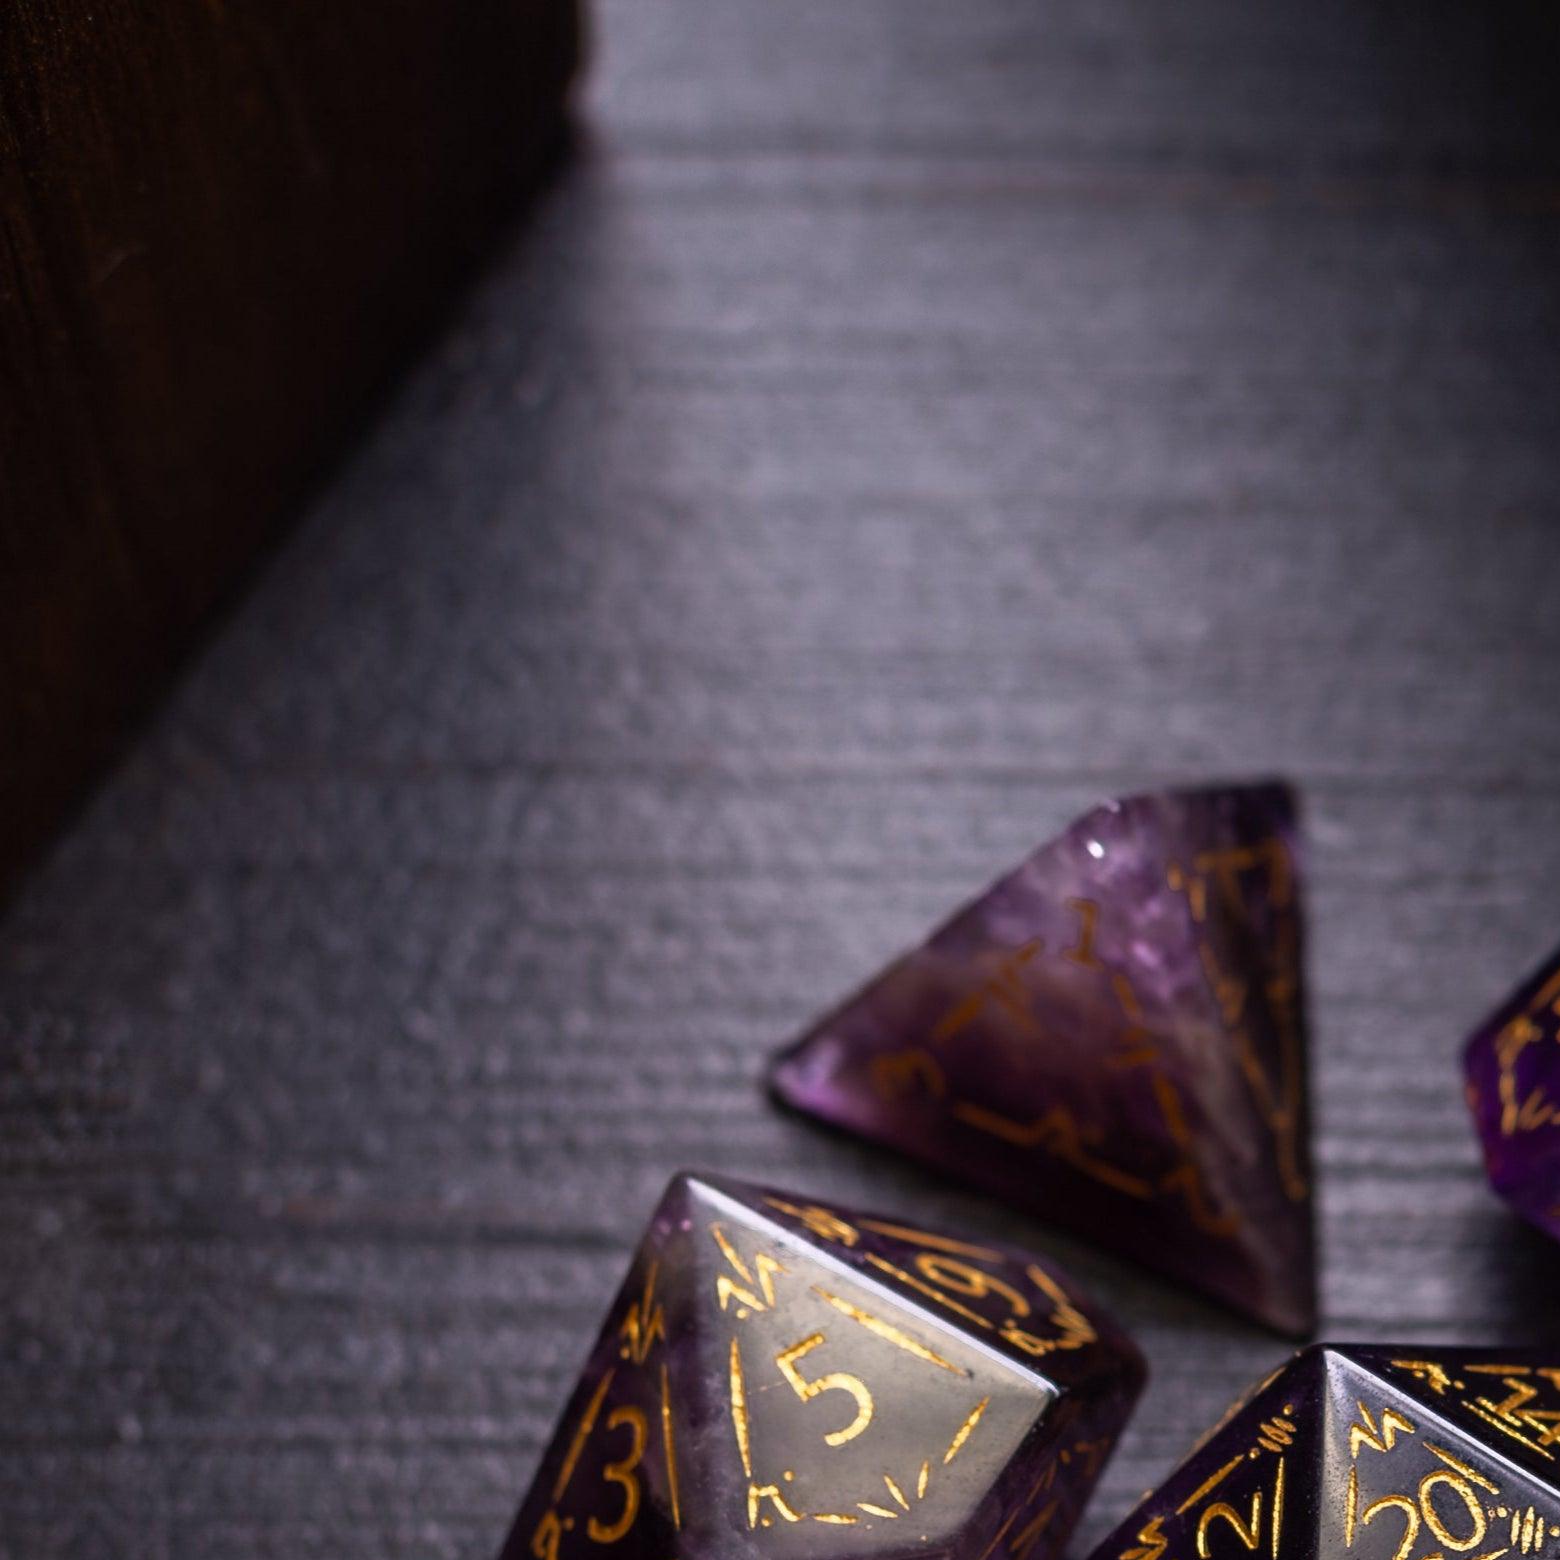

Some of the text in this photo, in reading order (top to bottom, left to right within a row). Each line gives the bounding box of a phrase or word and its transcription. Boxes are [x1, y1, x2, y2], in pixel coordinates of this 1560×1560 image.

[775, 1333, 873, 1447] 5
[587, 1406, 648, 1543] 3
[1198, 1491, 1262, 1560] 2
